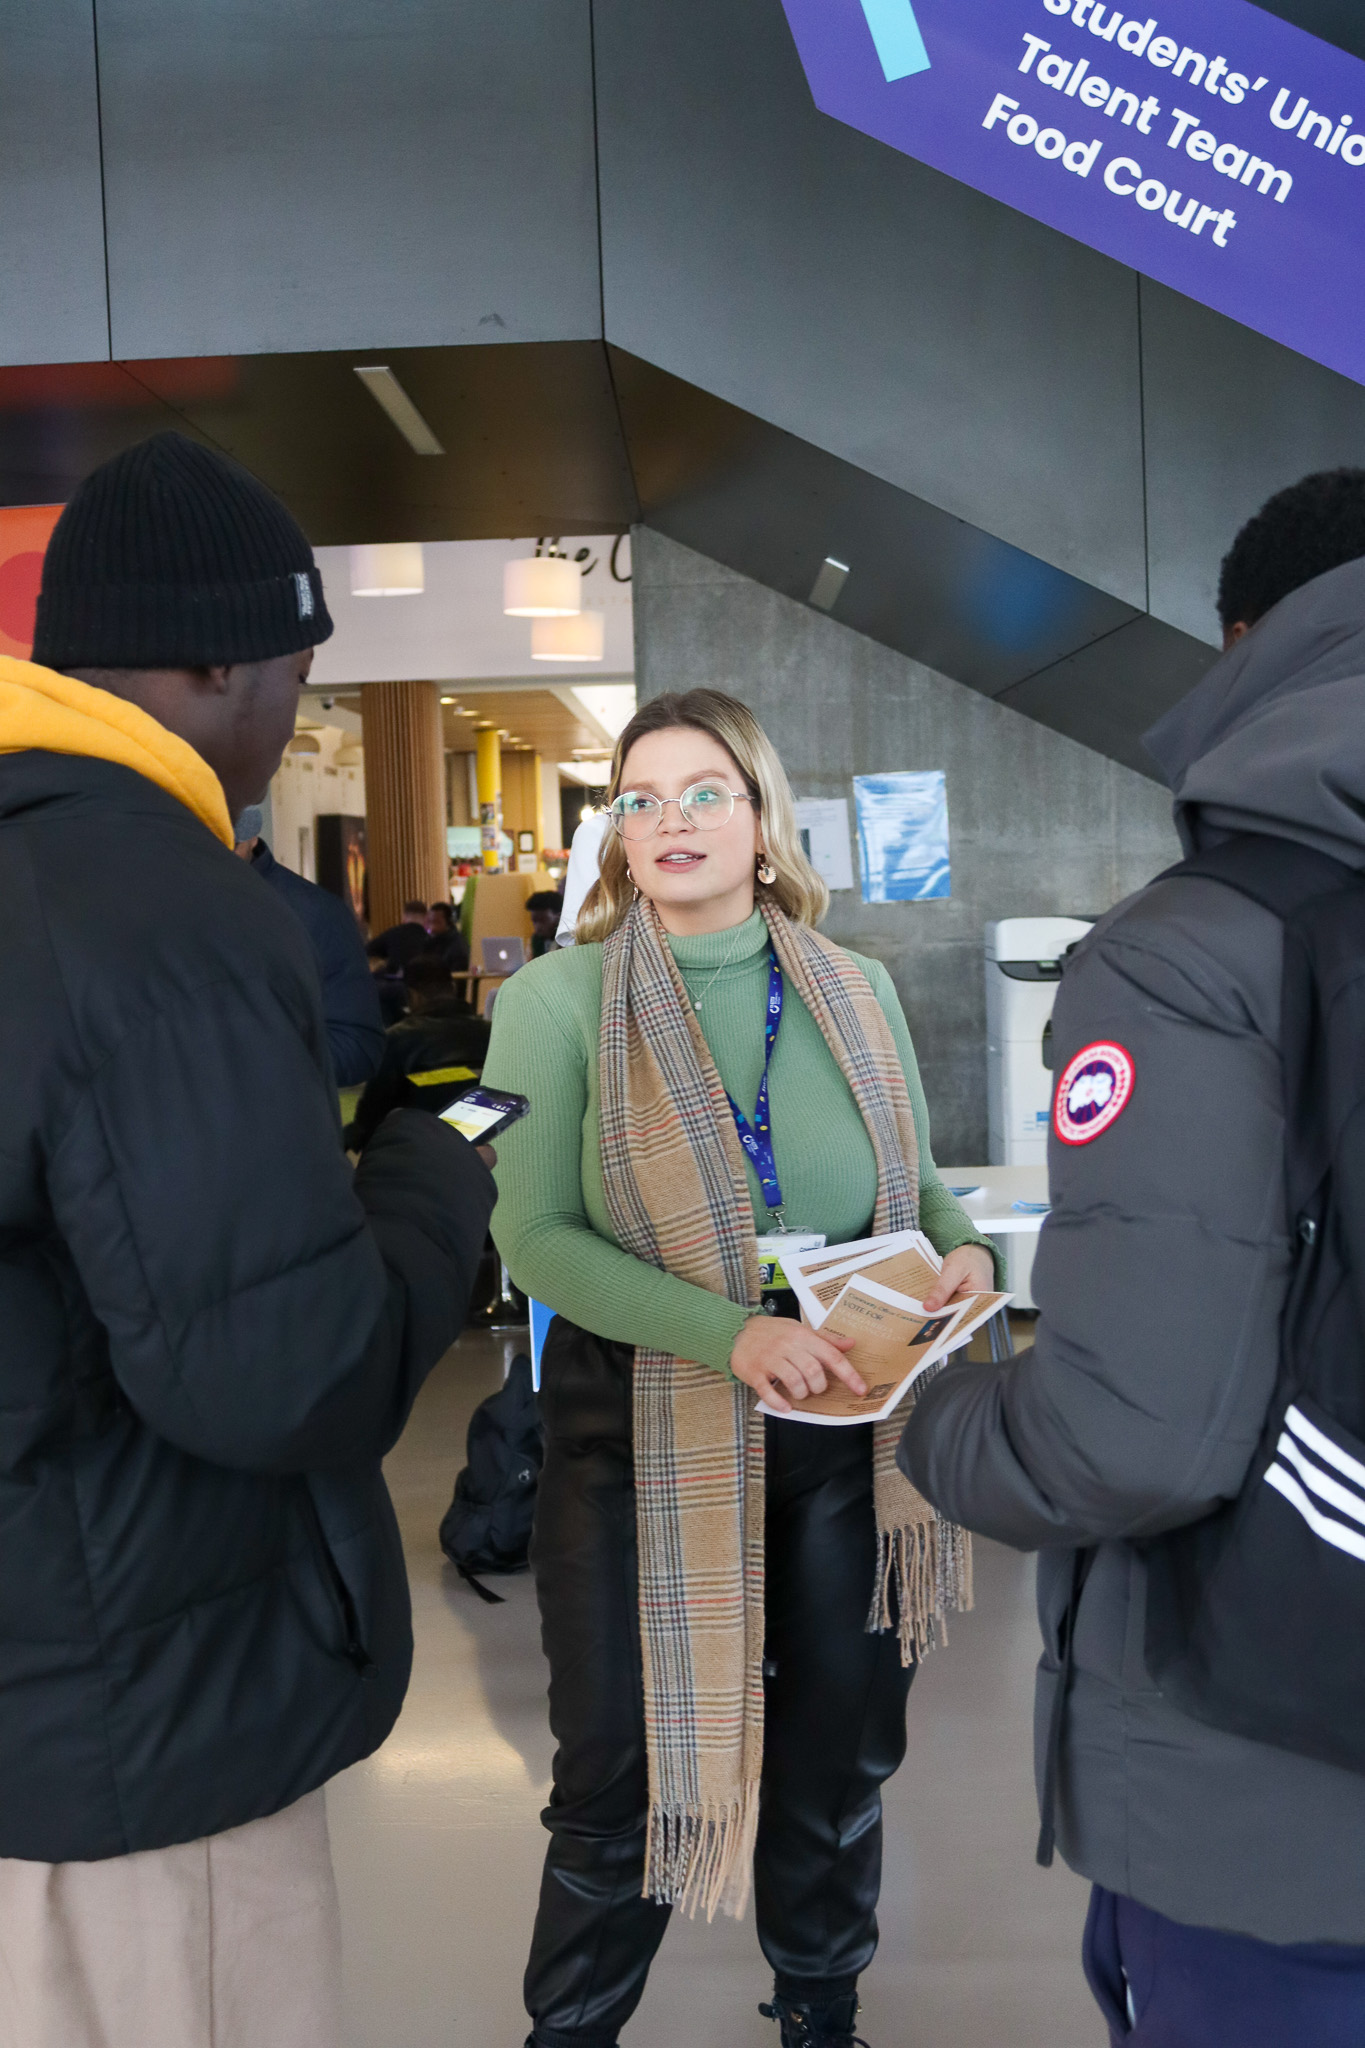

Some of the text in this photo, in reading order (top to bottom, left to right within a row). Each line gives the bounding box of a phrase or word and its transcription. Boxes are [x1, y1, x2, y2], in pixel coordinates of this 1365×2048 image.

[981, 93, 1237, 248] Food Court
[1018, 32, 1293, 203] Talent Team
[843, 1300, 884, 1321] VOTE FOR
